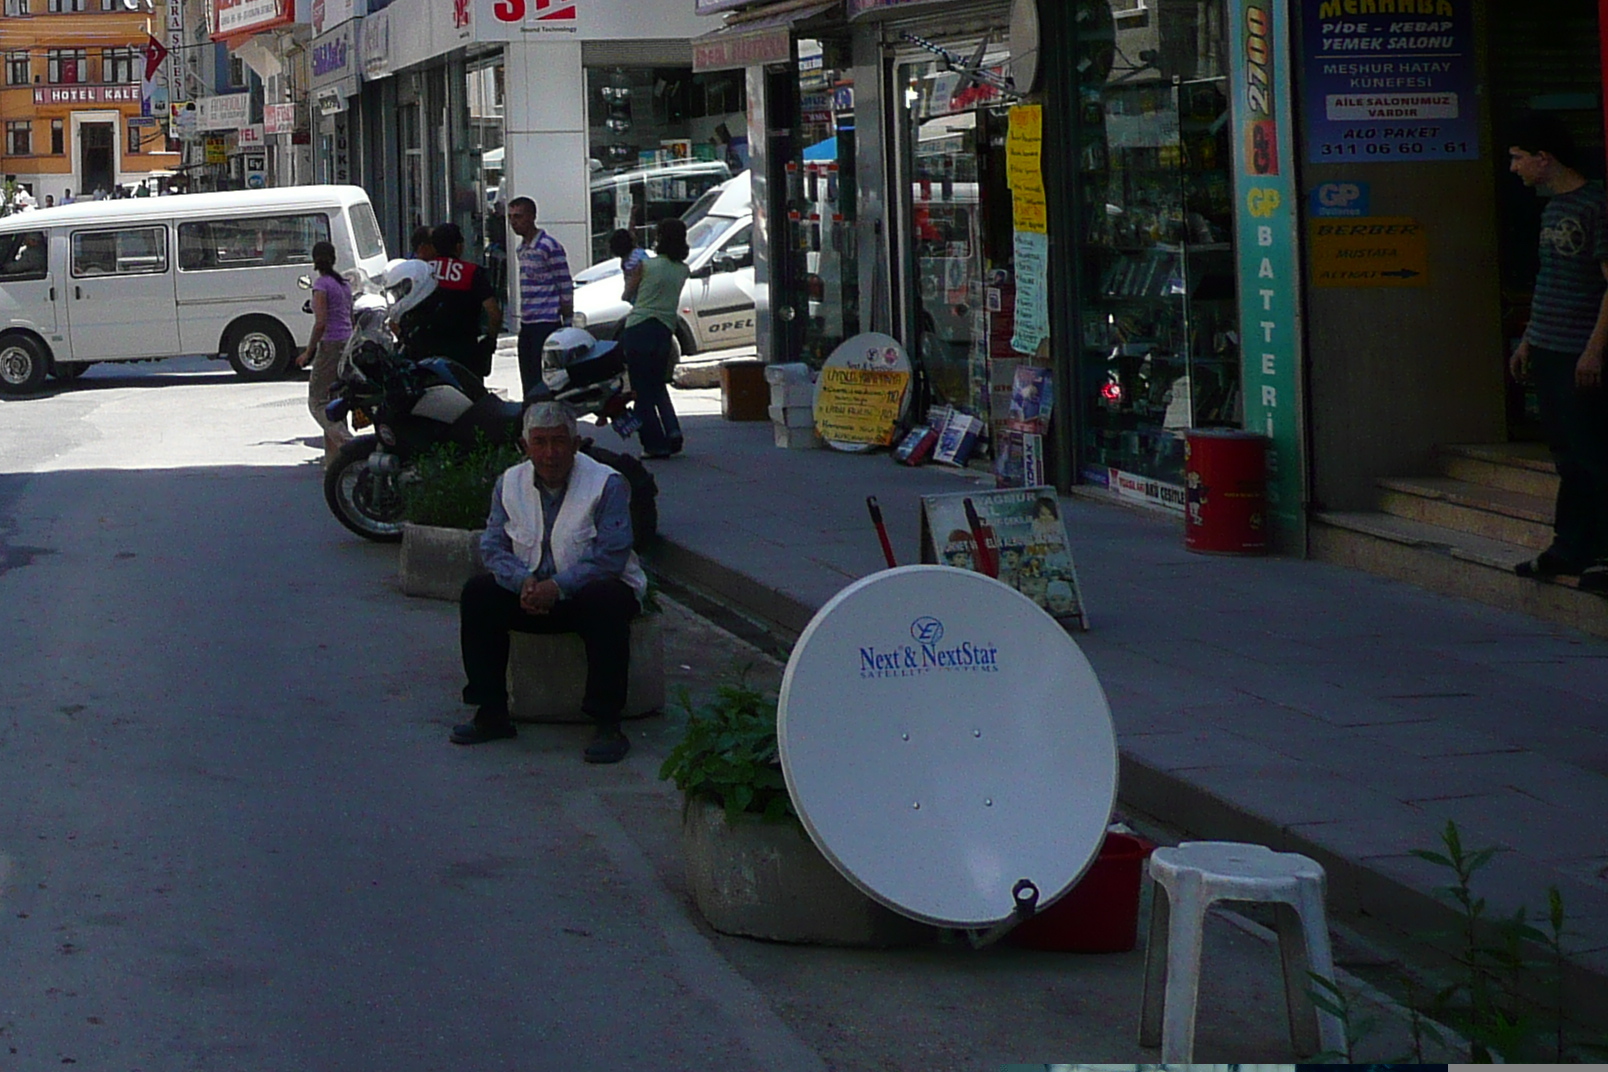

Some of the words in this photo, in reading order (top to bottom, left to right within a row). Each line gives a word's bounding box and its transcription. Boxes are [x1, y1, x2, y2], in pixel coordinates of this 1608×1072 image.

[1322, 22, 1369, 35] PİDE
[1389, 21, 1454, 35] KEBAP
[1321, 37, 1384, 51] YEMEK
[1386, 36, 1455, 50] SALONU
[1246, 5, 1268, 116] 2700
[1323, 62, 1394, 77] MEŞHUR
[1398, 61, 1452, 74] HATAY
[1350, 74, 1433, 89] KÜNEFESİ
[51, 89, 96, 101] HOTEL
[104, 88, 140, 100] KALE
[1334, 95, 1363, 107] AİLE
[1366, 95, 1451, 107] SALONUMUZ
[1368, 107, 1418, 118] VARDIR
[1343, 127, 1376, 139] ALO
[1384, 126, 1441, 138] PAKET
[1253, 124, 1270, 173] GP
[1321, 141, 1358, 156] 311
[1368, 141, 1392, 155] 06
[1398, 140, 1423, 155] 60
[1445, 140, 1468, 154] 61
[1246, 187, 1280, 218] GP
[1318, 183, 1360, 207] GP
[1317, 223, 1419, 237] BERBER
[432, 258, 464, 282] LİS
[708, 318, 755, 334] OPEL
[859, 645, 900, 671] Next
[904, 645, 918, 669] &
[922, 641, 998, 668] NextStar
